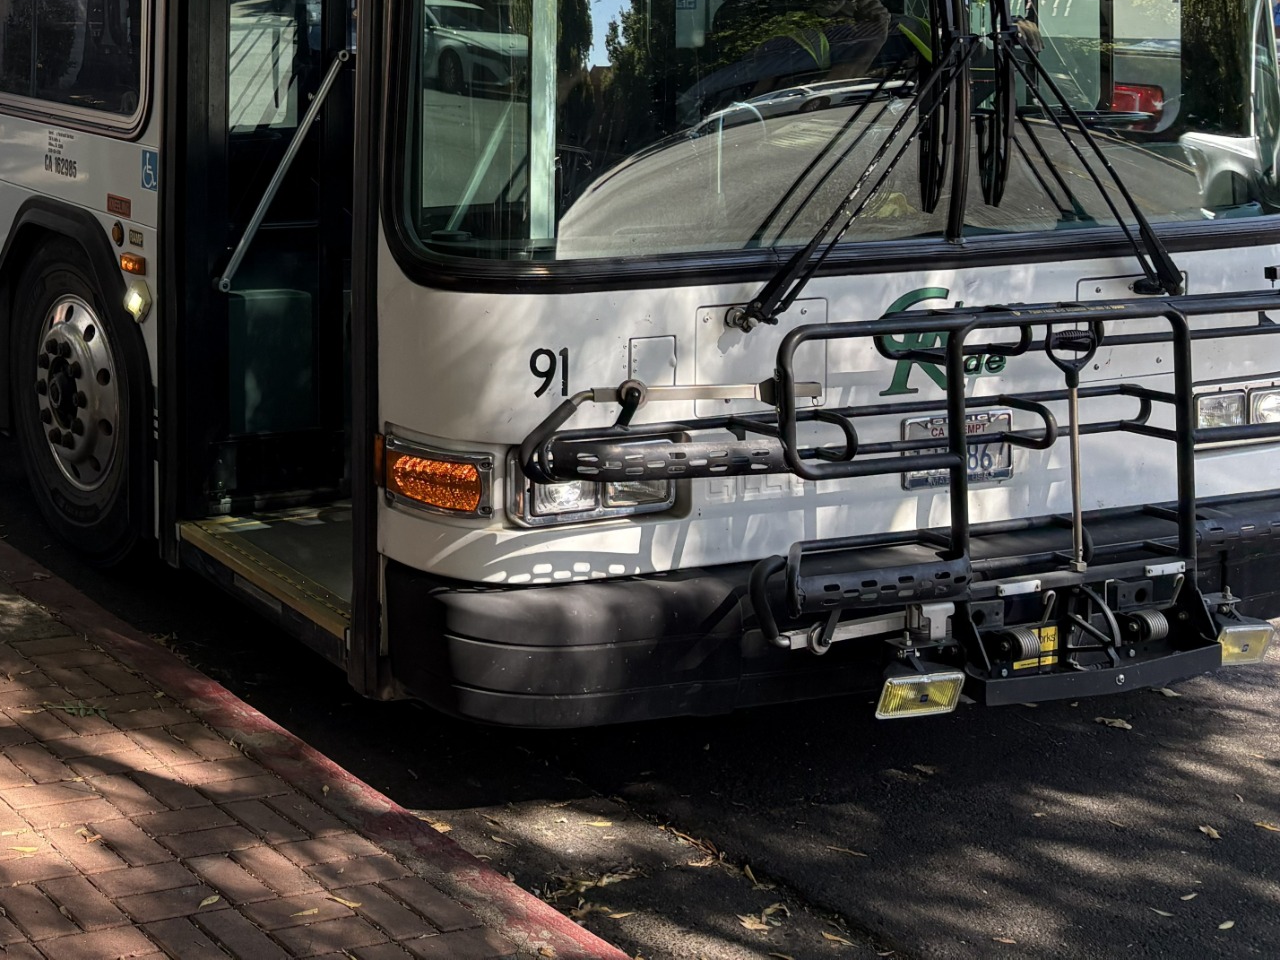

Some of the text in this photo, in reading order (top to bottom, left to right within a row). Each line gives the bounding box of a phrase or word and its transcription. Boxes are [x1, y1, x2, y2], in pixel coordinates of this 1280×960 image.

[44, 153, 77, 178] CA 162985
[529, 347, 569, 399] 91
[930, 426, 945, 438] CA
